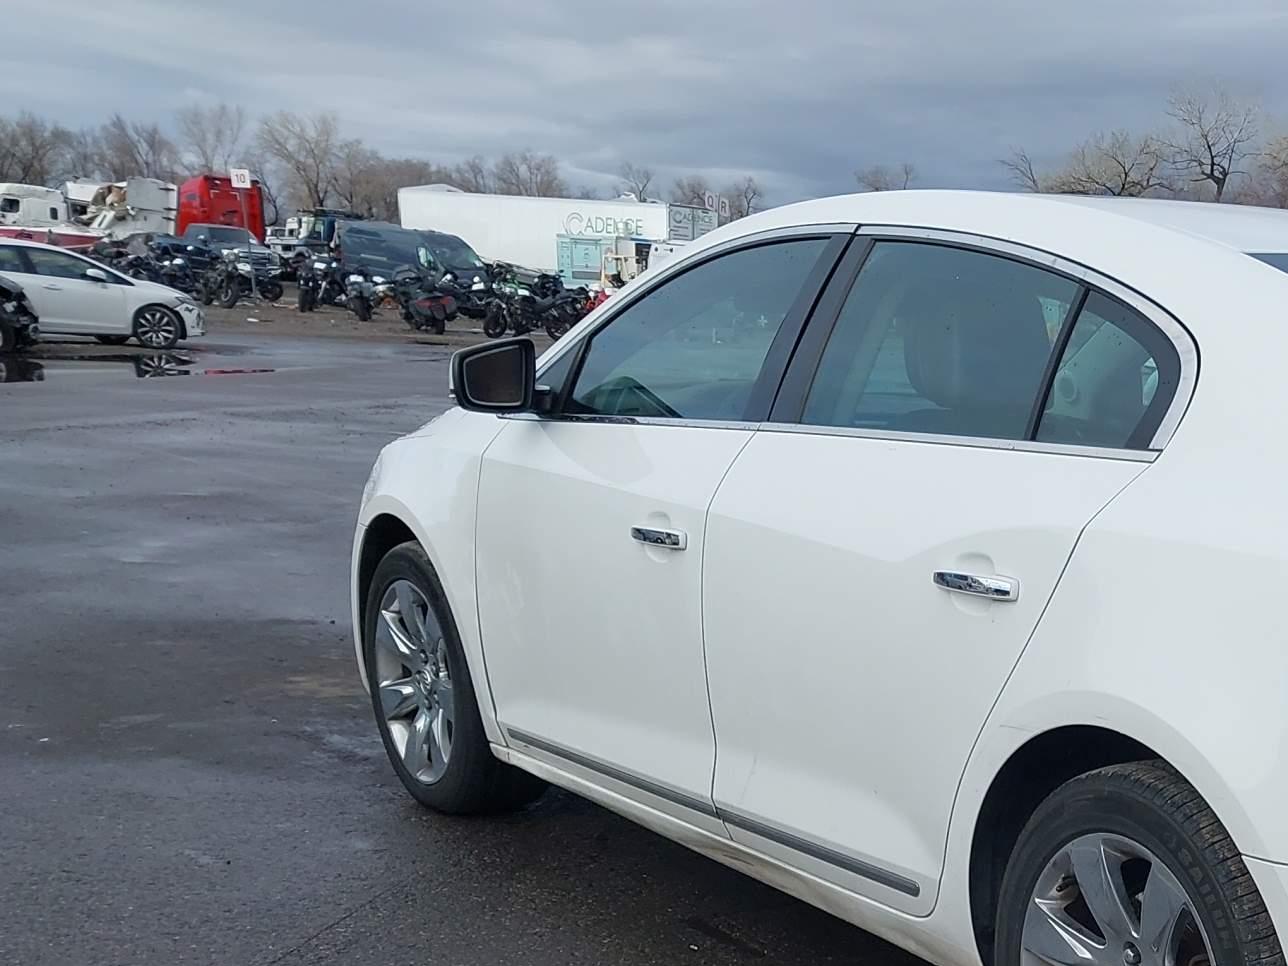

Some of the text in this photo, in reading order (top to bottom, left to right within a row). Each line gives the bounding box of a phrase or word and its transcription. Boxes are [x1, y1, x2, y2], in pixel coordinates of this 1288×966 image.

[234, 173, 246, 184] 10
[707, 195, 715, 209] Q
[720, 200, 727, 214] R
